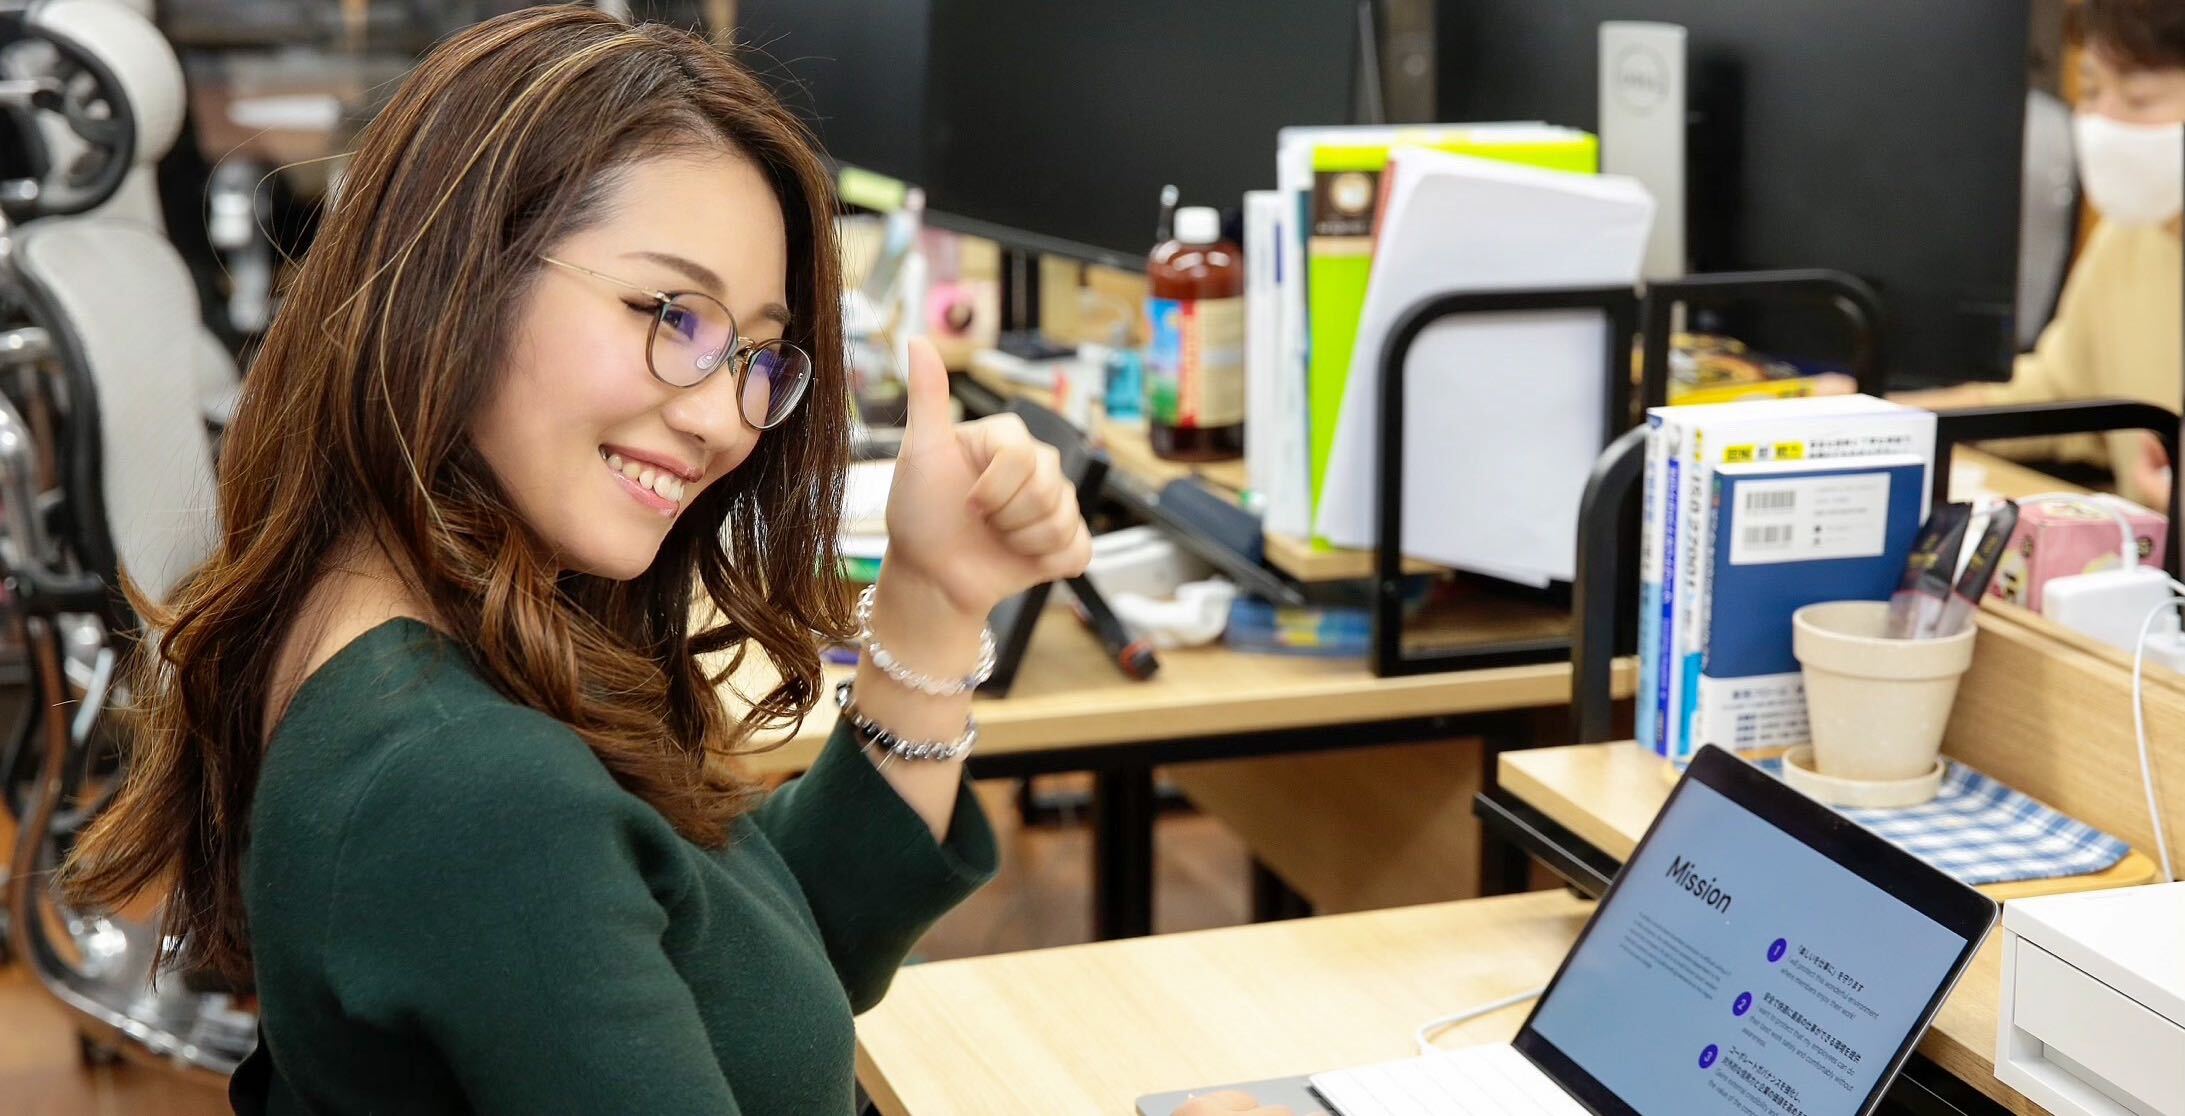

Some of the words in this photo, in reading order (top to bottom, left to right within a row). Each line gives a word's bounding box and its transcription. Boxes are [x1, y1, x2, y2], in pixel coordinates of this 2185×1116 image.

[1666, 855, 1733, 914] Mission
[1737, 998, 1747, 1011] 2
[1703, 1050, 1713, 1062] 3
